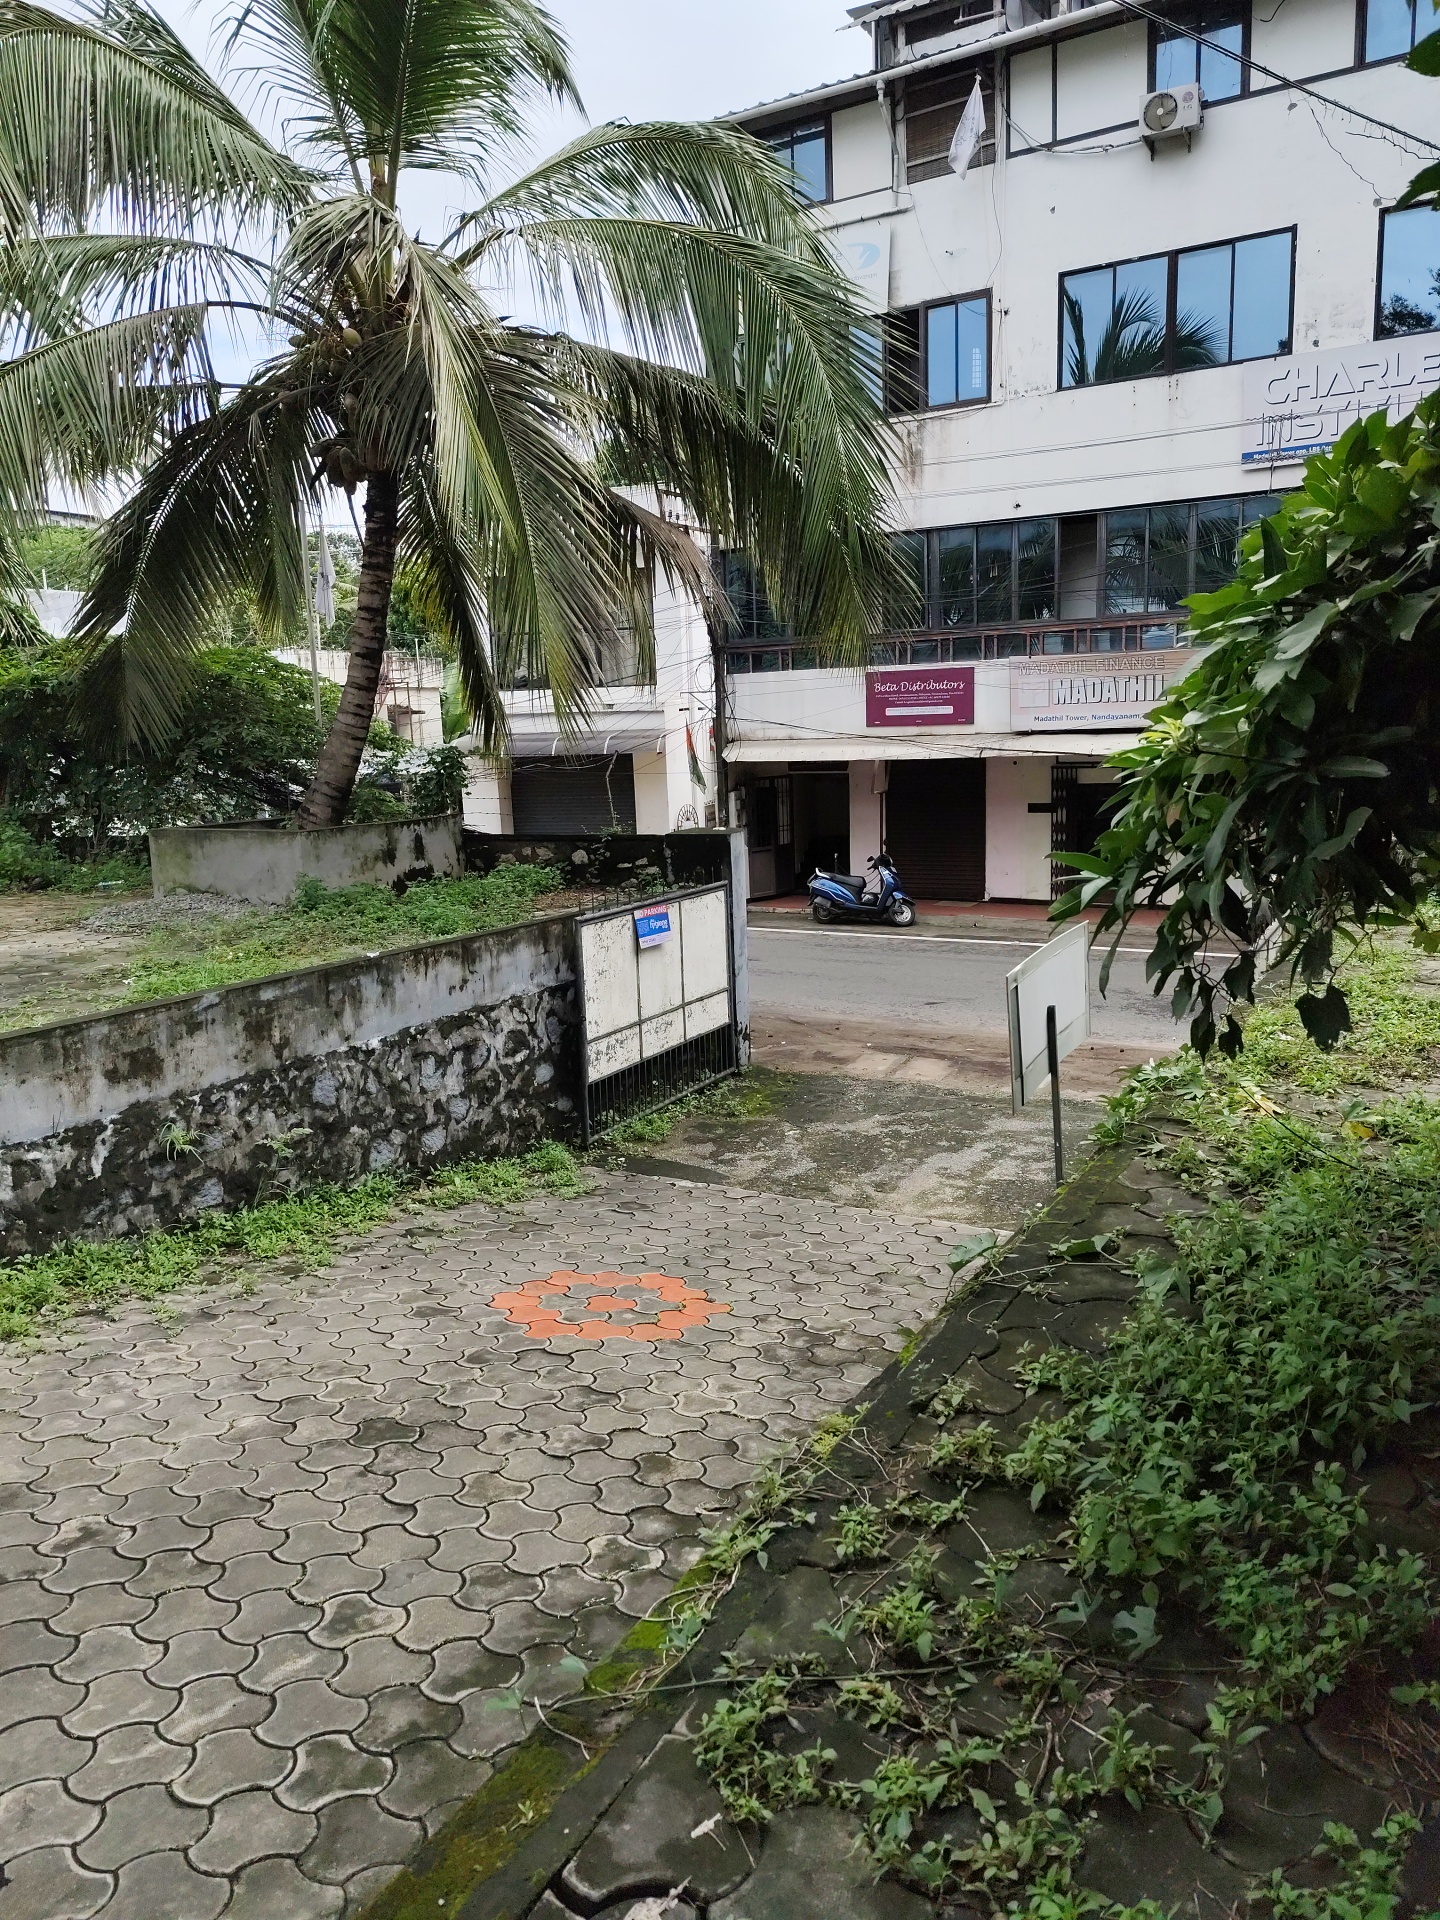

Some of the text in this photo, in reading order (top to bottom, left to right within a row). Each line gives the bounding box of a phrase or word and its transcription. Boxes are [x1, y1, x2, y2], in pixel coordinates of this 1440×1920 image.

[1019, 655, 1165, 676] MADATHIL FINANCE
[874, 679, 965, 693] Beta Distributors
[1052, 674, 1168, 706] MADATHIL
[1033, 714, 1064, 722] Madathil
[1065, 714, 1089, 722] Tower,
[644, 905, 667, 916] PARKING
